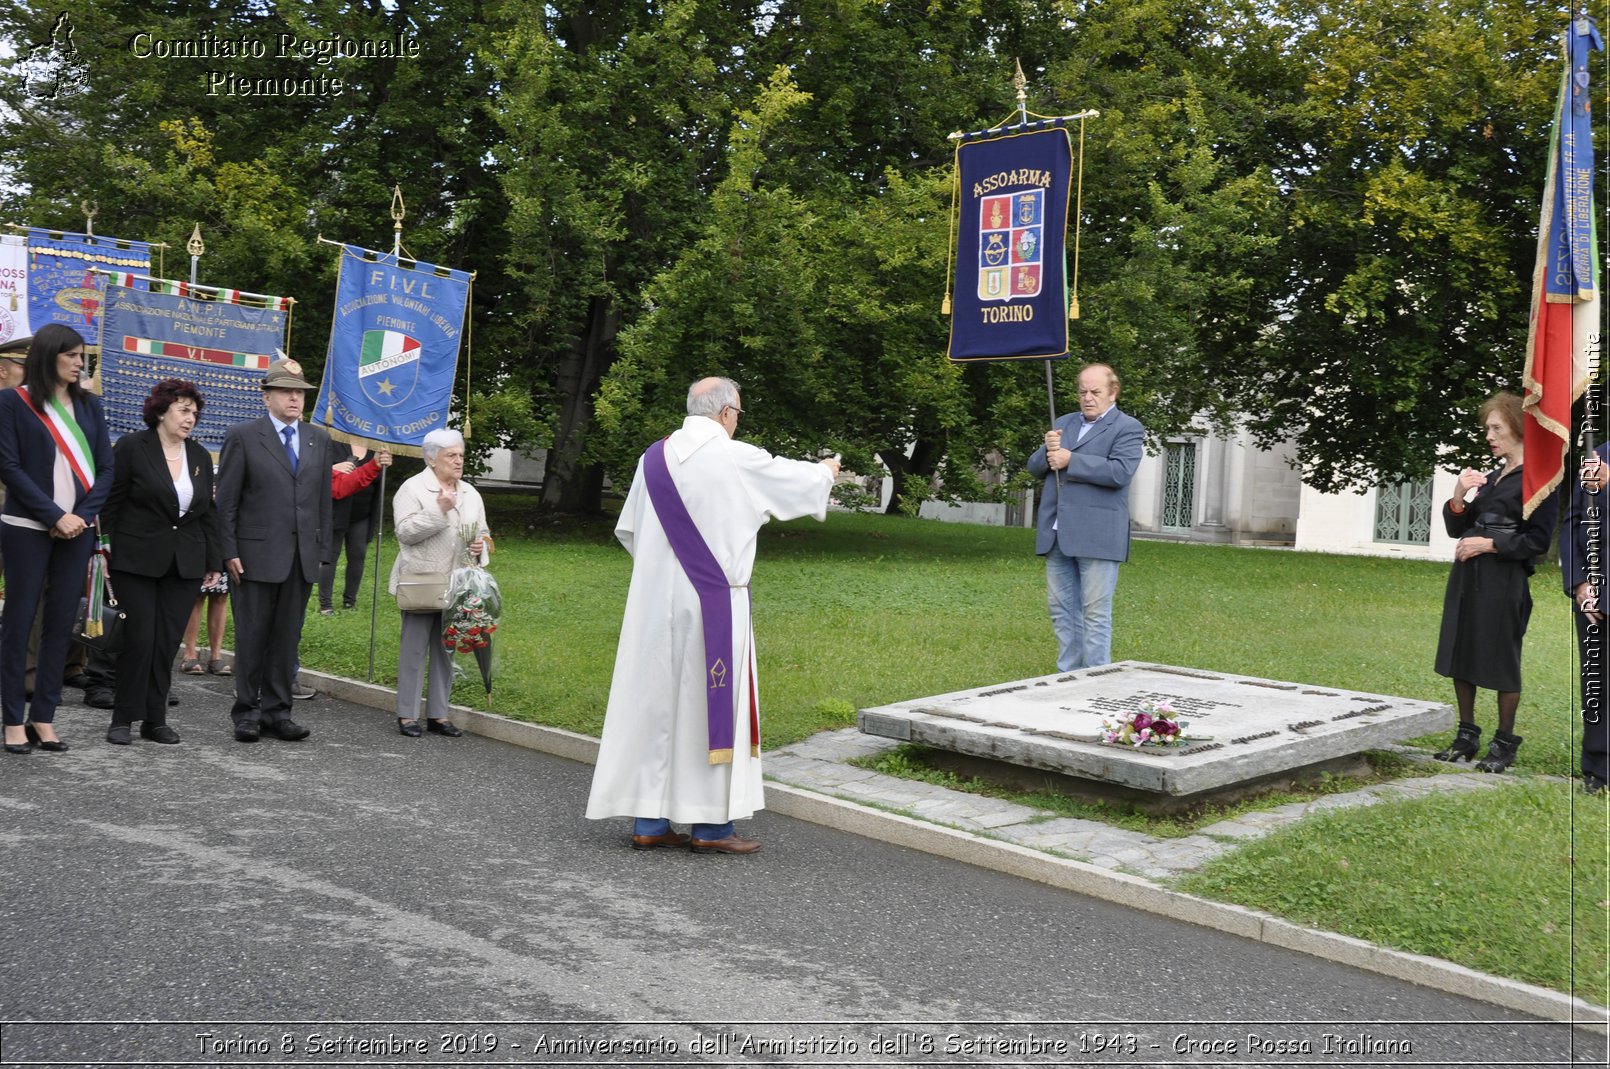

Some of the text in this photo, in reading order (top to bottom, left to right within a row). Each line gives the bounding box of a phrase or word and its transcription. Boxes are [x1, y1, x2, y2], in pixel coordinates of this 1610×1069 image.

[972, 168, 1052, 198] ASSOARMA
[1577, 168, 1591, 283] GUERRA DI LIBERAZIONE
[0, 268, 25, 279] OSS
[115, 301, 171, 318] ASSOCIAZIONE
[172, 311, 213, 325] NAZIONALE
[214, 317, 255, 330] PARTIGIANI
[340, 294, 388, 317] ASSOCIAZIONE
[392, 294, 430, 315] VOLONTARI
[981, 304, 1033, 324] TORINO
[174, 321, 227, 338] PIEMONTE
[376, 315, 416, 333] PIEMONTE
[361, 351, 415, 375] AUTONOMI
[376, 424, 389, 435] DI
[394, 411, 440, 436] TORINO
